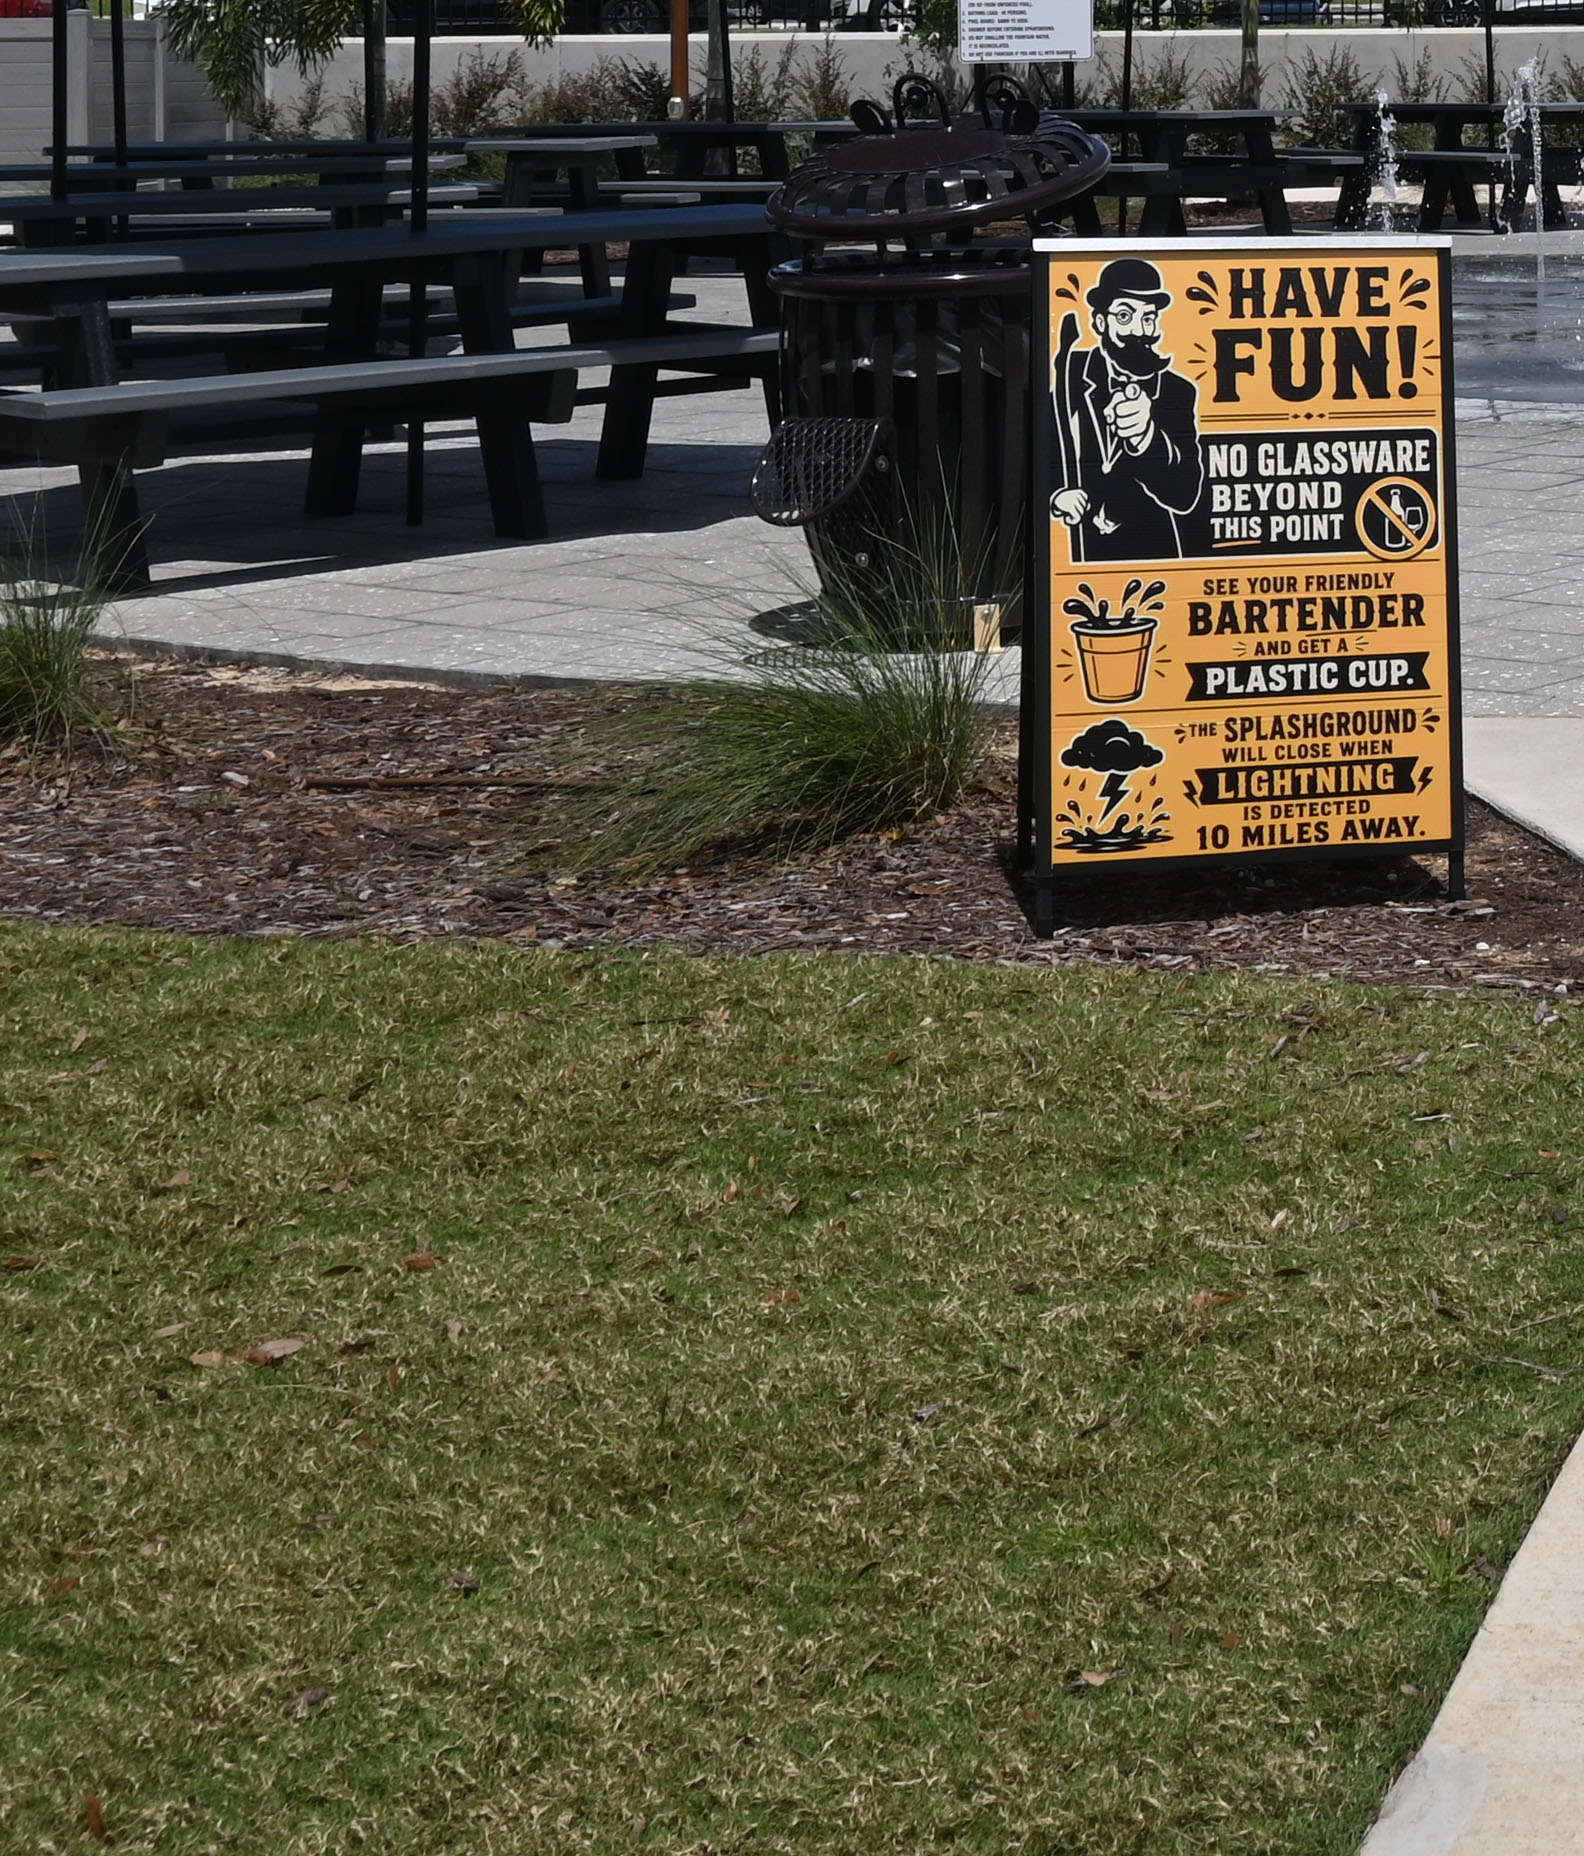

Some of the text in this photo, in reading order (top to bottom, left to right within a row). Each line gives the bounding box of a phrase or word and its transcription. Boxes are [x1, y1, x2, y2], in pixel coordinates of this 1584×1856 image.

[1228, 266, 1391, 318] HAVE
[1211, 325, 1418, 403] FUN!
[1208, 440, 1431, 478] NO GLASSWARE
[1211, 481, 1342, 512] BEYOND
[1210, 514, 1344, 542] THIS POINT
[1203, 573, 1395, 595] SEE YOUR FRIENDLY
[1187, 593, 1426, 636] BARTENDER
[1254, 638, 1349, 656] AND GET A
[1206, 659, 1414, 694] PLASTIC CUP.
[1189, 708, 1417, 742] THE SPLASHGROUND
[1222, 740, 1393, 763] WILL CLOSE WHEN
[1217, 763, 1395, 799] LIGHTNING
[1243, 800, 1371, 820] IS DETECTED
[1196, 815, 1426, 850] 10 MILES AWAY.
